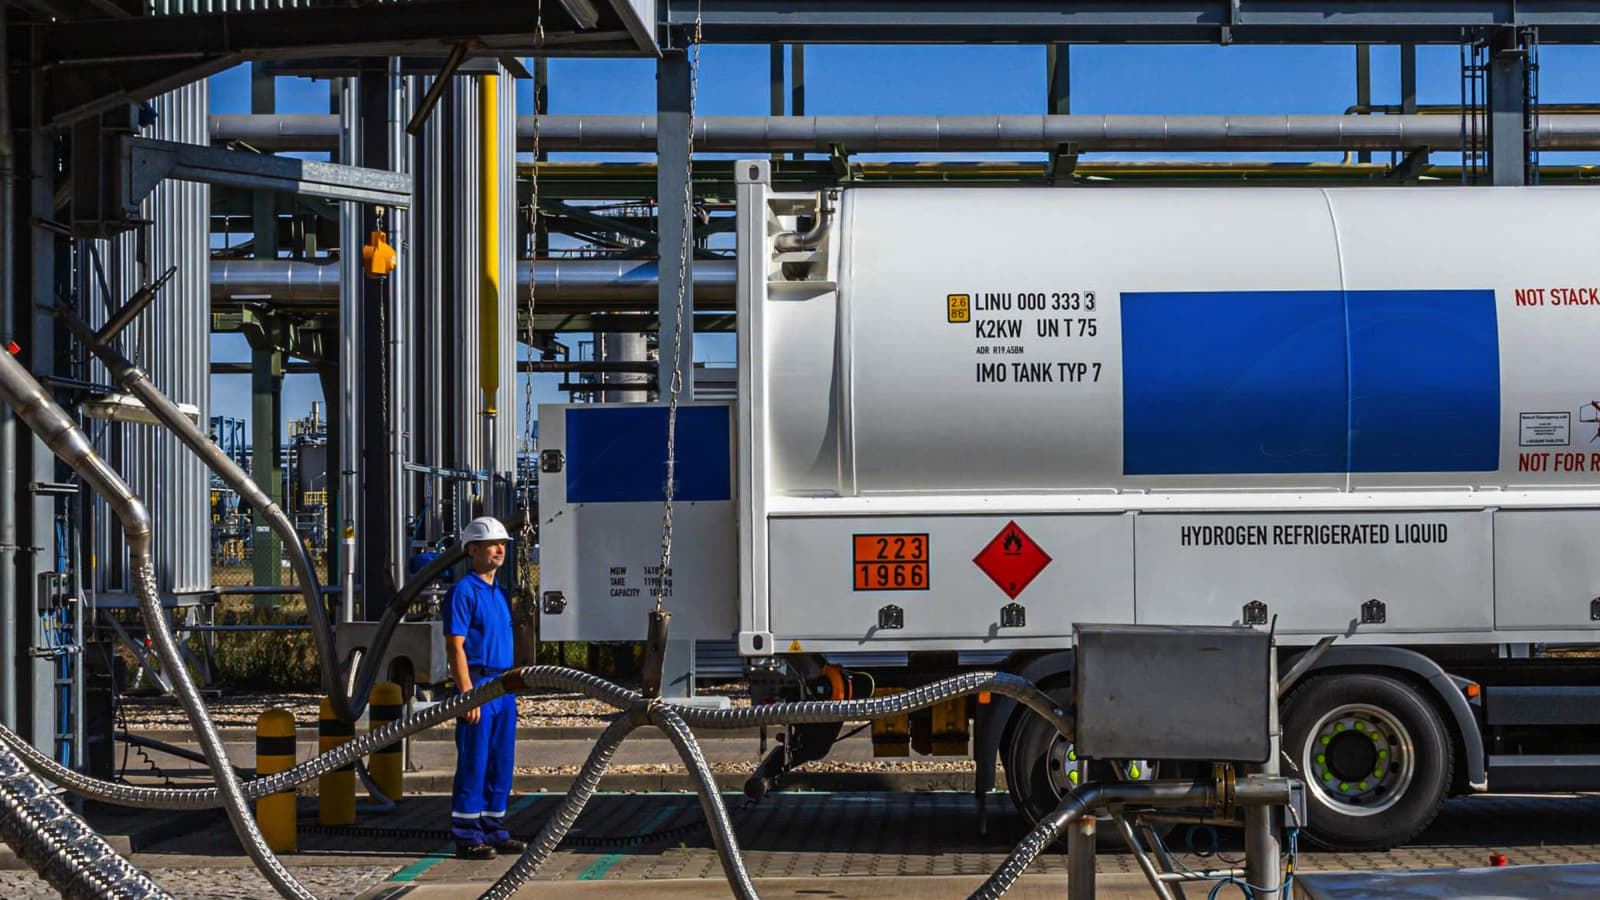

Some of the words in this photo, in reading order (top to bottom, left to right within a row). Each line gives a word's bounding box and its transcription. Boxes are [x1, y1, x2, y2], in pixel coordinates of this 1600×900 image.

[975, 293, 1012, 310] LINU
[1018, 293, 1046, 310] 000
[1052, 293, 1080, 310] 333
[1085, 292, 1095, 310] 3
[1515, 288, 1545, 306] NOT
[1551, 288, 1600, 305] STACK
[975, 319, 1022, 338] K2KW
[1037, 319, 1059, 337] UN
[1064, 319, 1073, 337] T
[1078, 319, 1097, 337] 75
[976, 346, 990, 355] ADR
[976, 363, 1007, 382] IMO
[1011, 363, 1052, 382] TANK
[1057, 363, 1087, 382] TYP
[1092, 363, 1102, 382] 7
[1519, 453, 1550, 472] NOT
[1554, 453, 1585, 472] FOR
[1181, 525, 1267, 546] HYDROGEN
[1273, 524, 1389, 545] REFRIGERATED
[1395, 523, 1448, 544] LIQUID
[877, 538, 923, 559] 223
[861, 564, 923, 587] 1966
[610, 588, 640, 597] CAPACITY
